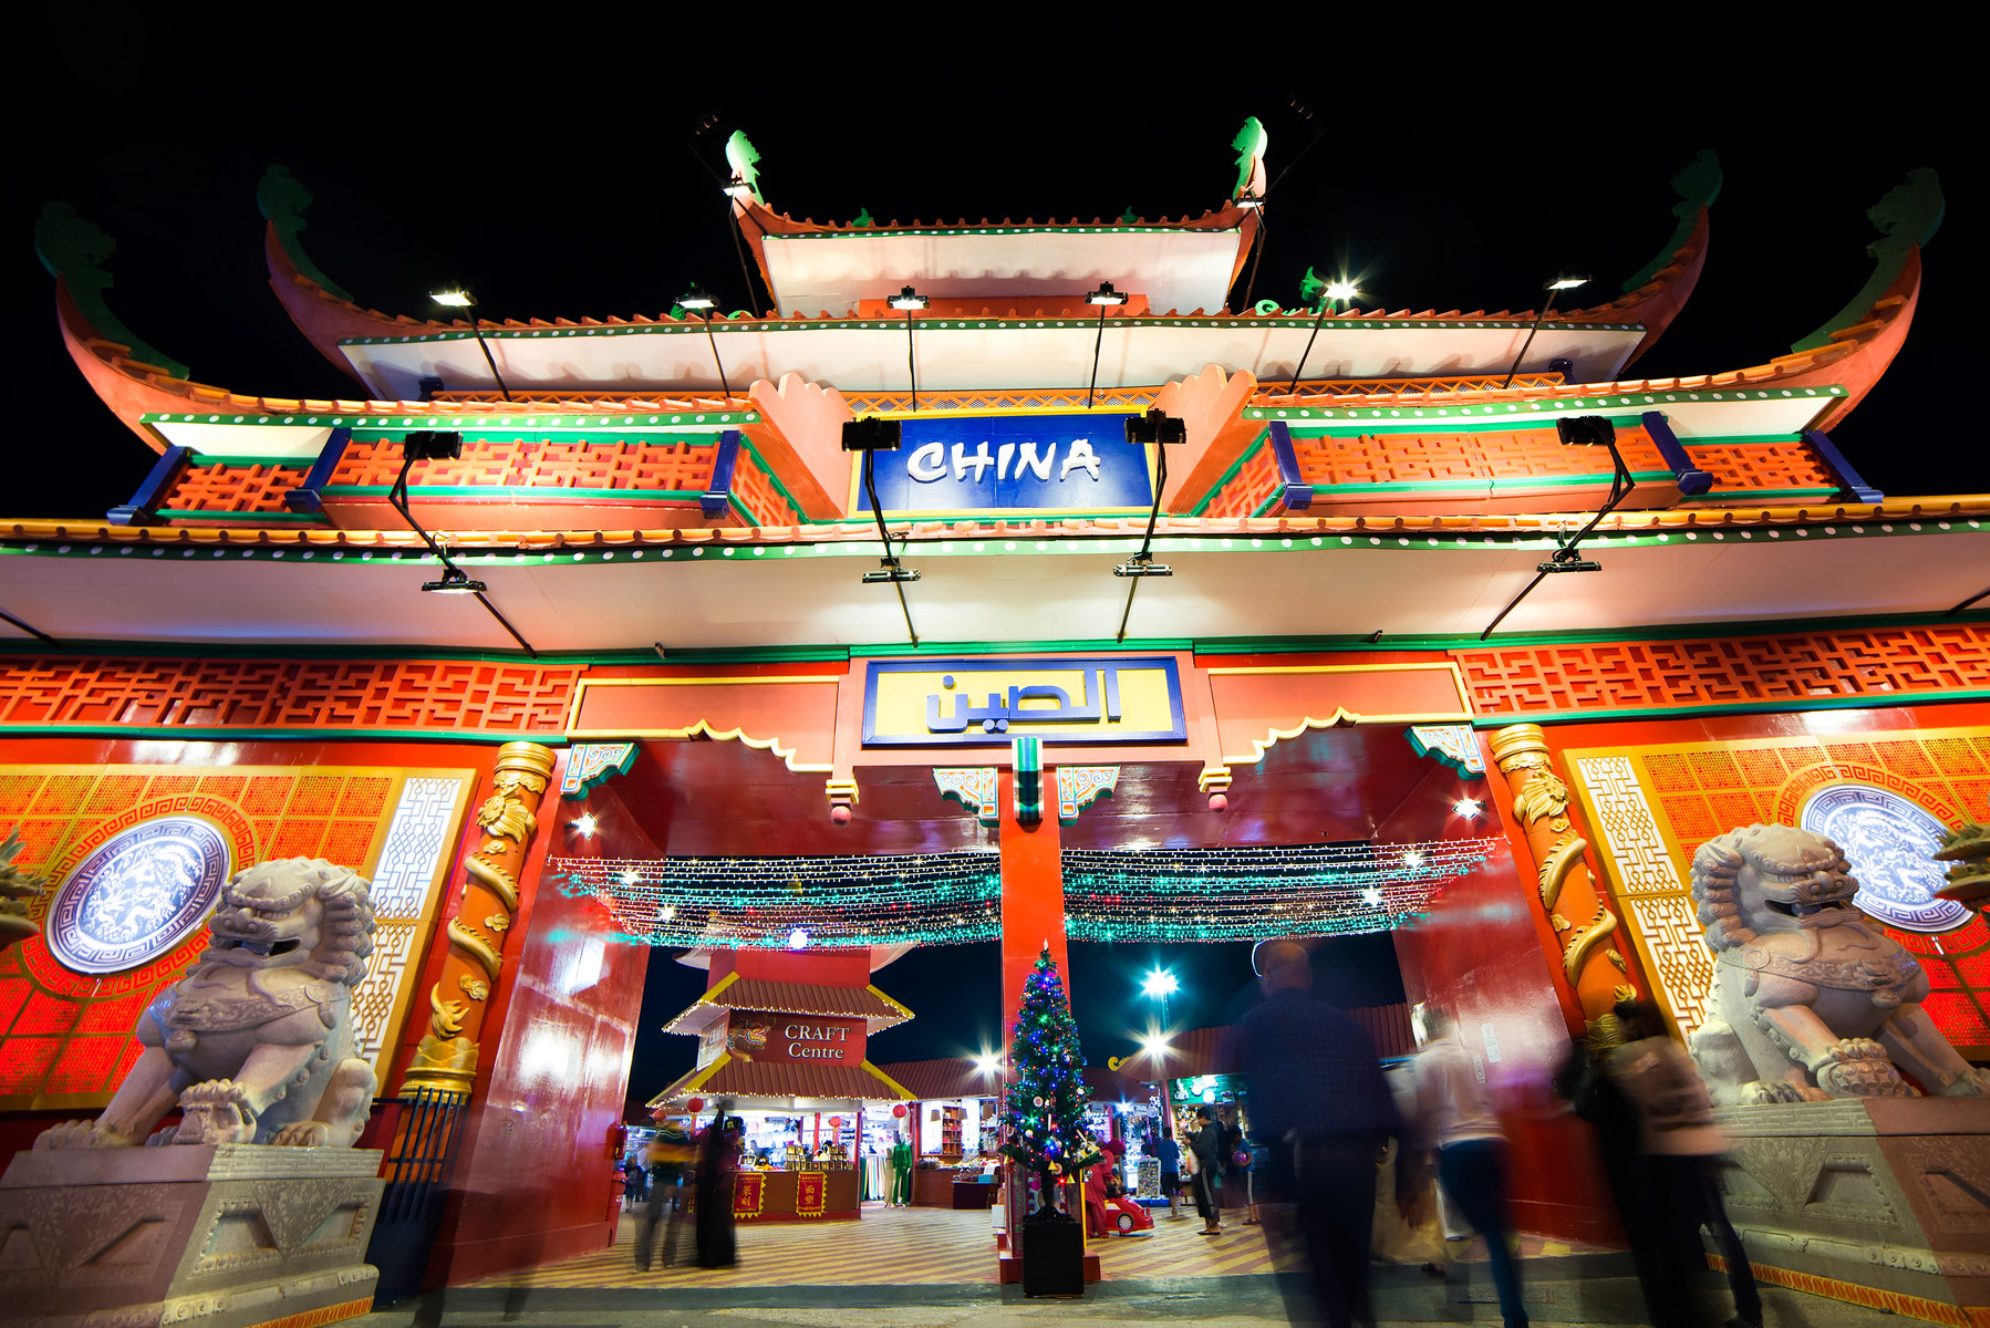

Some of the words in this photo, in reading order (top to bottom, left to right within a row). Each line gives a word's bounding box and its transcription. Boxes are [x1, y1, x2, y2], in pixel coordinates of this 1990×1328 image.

[908, 439, 1099, 481] CHINA
[926, 670, 1121, 732] الصين
[785, 1025, 849, 1041] CRAFT
[788, 1043, 844, 1058] Centre
